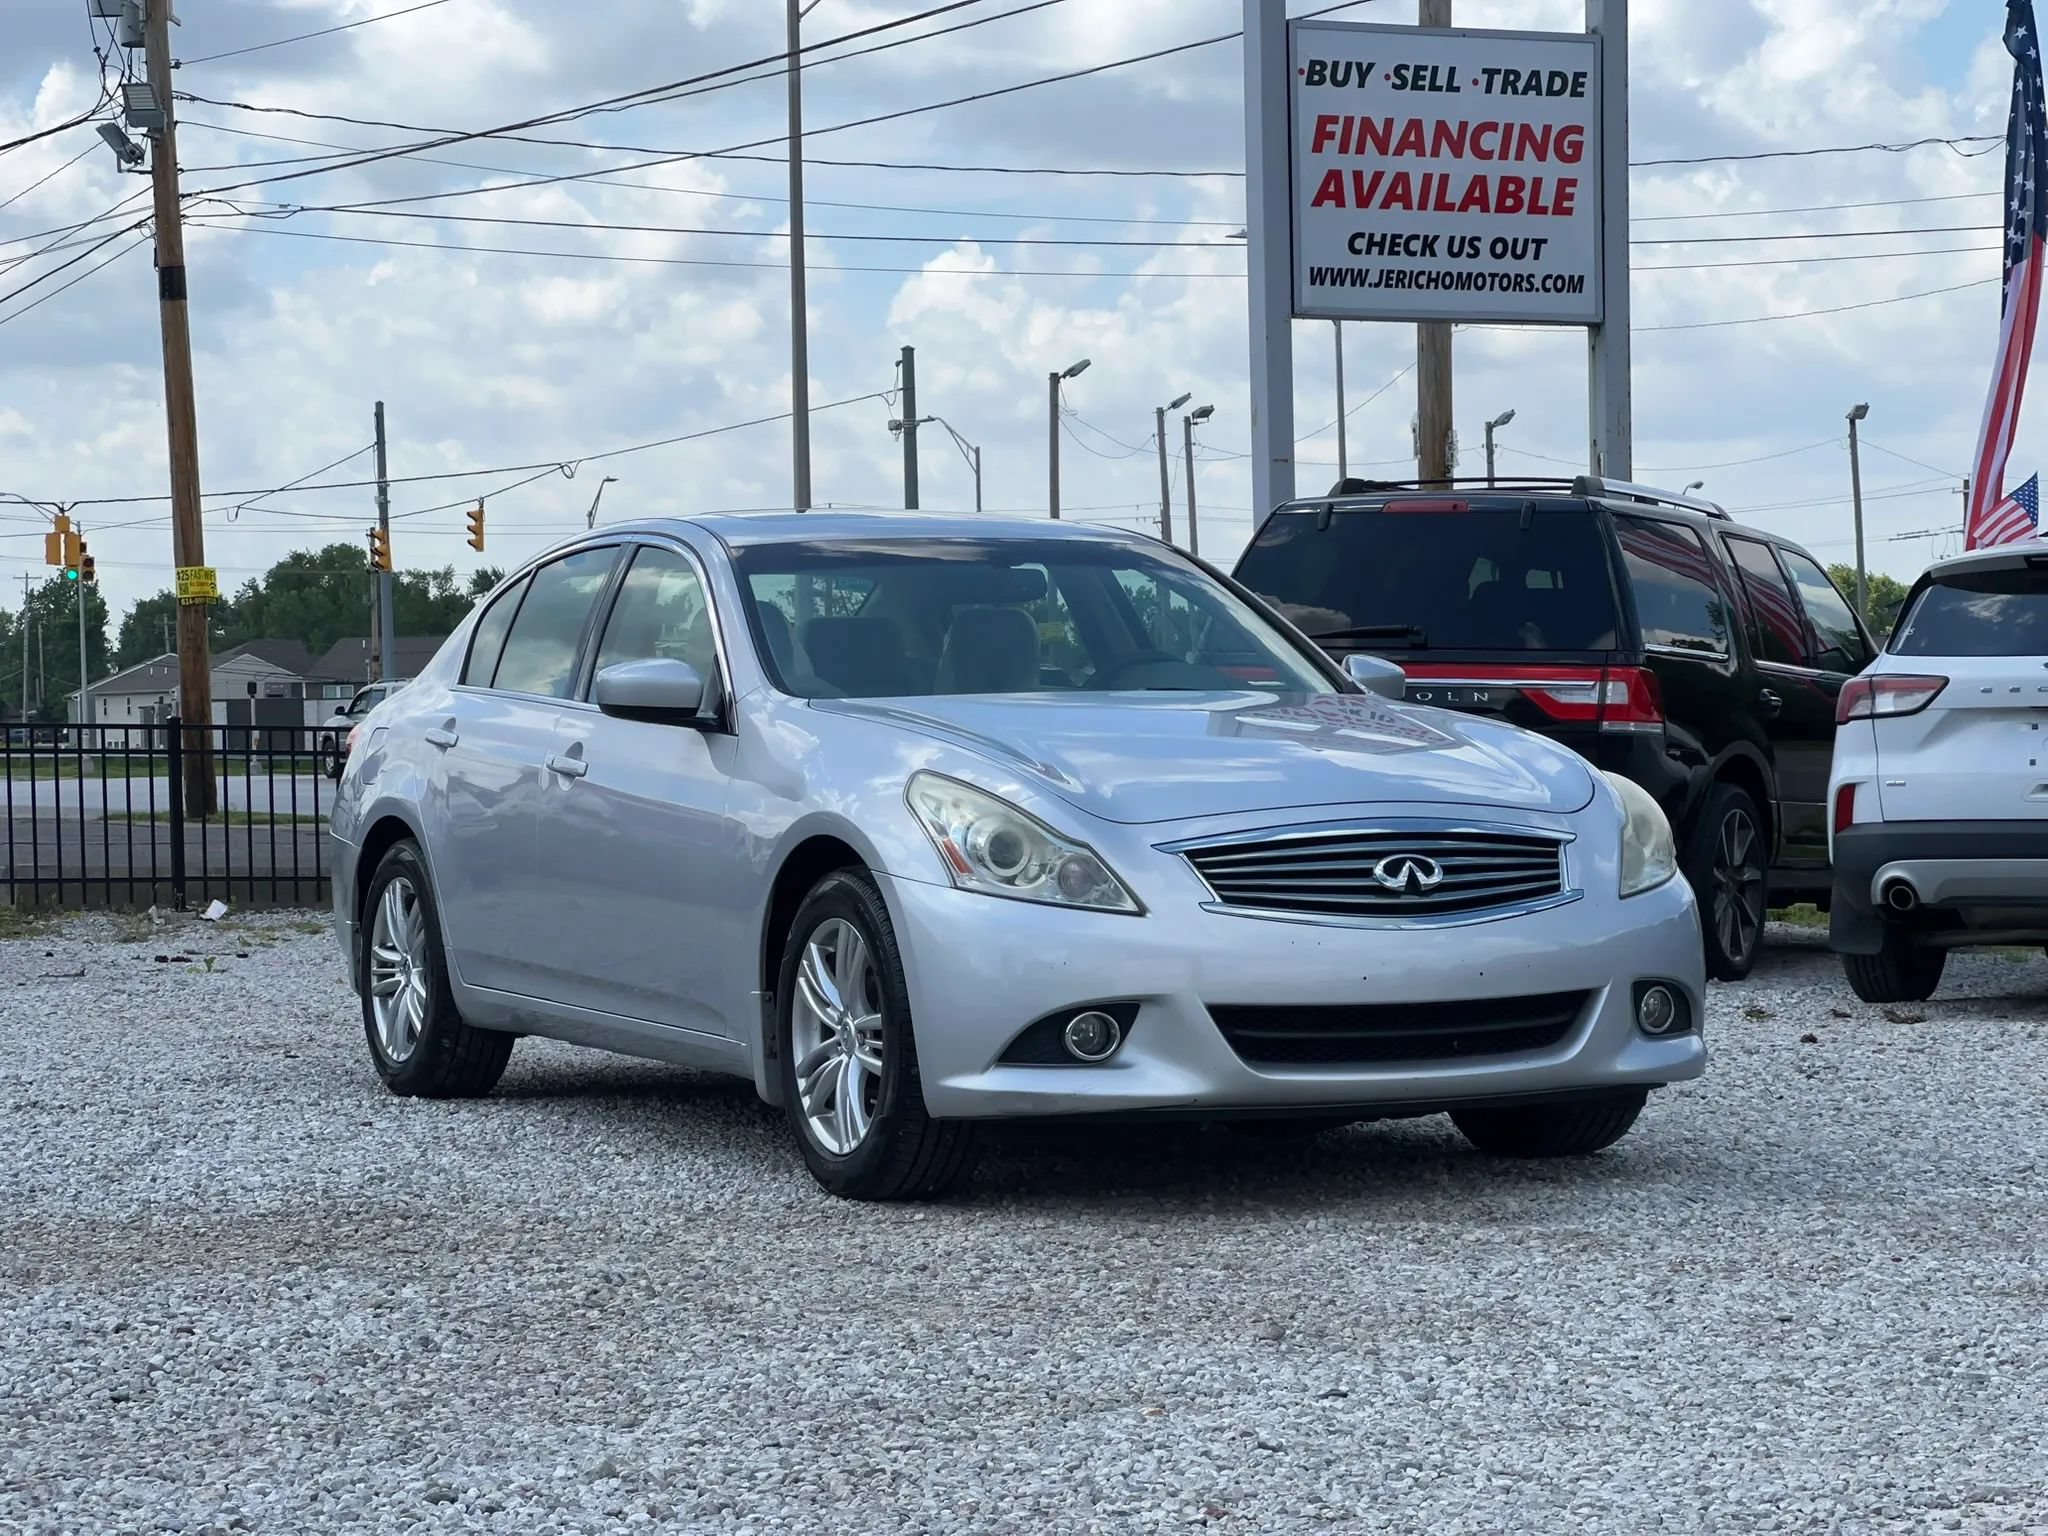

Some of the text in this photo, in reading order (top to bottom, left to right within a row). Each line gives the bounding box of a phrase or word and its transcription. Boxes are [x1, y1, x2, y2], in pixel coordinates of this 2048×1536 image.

[1311, 114, 1585, 164] FINANCING
[1310, 169, 1579, 217] AVAILABLE
[1347, 231, 1549, 261] CHECK US OUT
[1309, 265, 1585, 294] WWW.JERICHOMOTORS.COM
